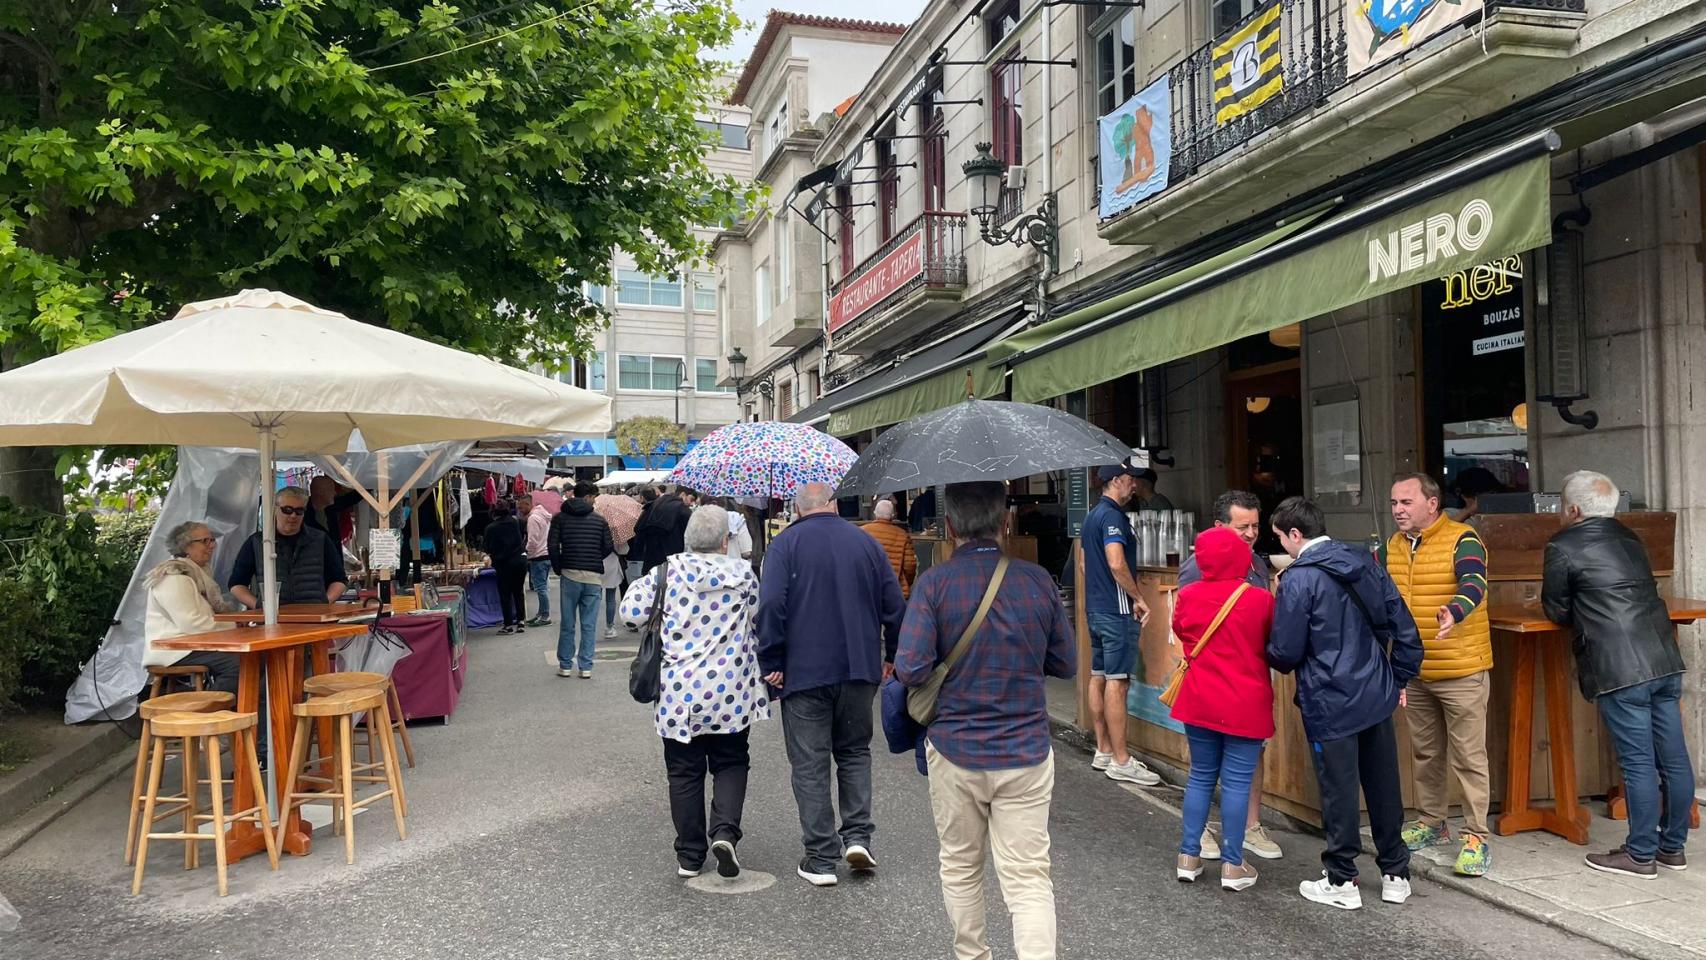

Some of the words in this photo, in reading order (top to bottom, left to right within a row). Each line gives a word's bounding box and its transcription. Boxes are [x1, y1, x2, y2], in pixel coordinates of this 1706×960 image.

[1368, 198, 1493, 282] NERO
[1440, 254, 1522, 309] ner
[1483, 307, 1521, 325] BOUZAS
[1476, 340, 1499, 352] CUCINA
[832, 415, 851, 431] NERO
